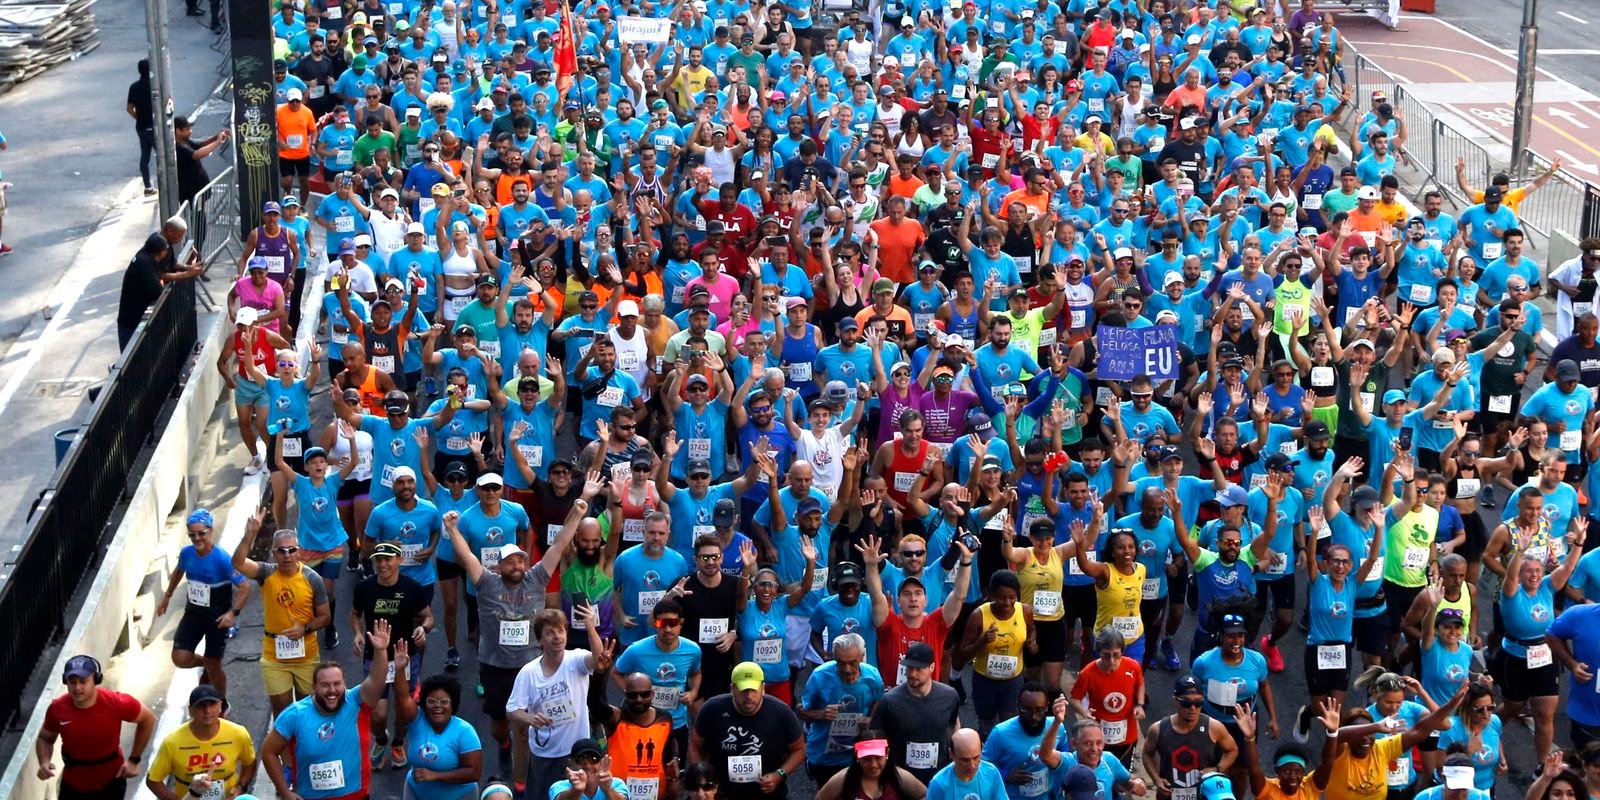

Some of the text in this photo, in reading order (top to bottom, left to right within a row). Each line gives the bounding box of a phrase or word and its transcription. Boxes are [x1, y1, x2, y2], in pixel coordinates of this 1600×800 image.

[1303, 185, 1312, 193] 30
[722, 222, 740, 232] LA
[1145, 347, 1172, 375] EU
[1407, 552, 1424, 561] 6012
[502, 627, 525, 636] 17093
[703, 625, 721, 634] 4493
[277, 641, 300, 650] 11089
[755, 645, 778, 655] 10920
[1319, 652, 1341, 660] 12945
[988, 661, 1013, 671] 24496
[655, 693, 674, 701] 3861
[547, 705, 567, 717] 9541
[833, 719, 857, 728] 16019
[721, 743, 737, 752] MR
[911, 750, 930, 759] 3398
[733, 764, 754, 773] 5058
[312, 770, 338, 781] 25621
[628, 784, 653, 794] 11857
